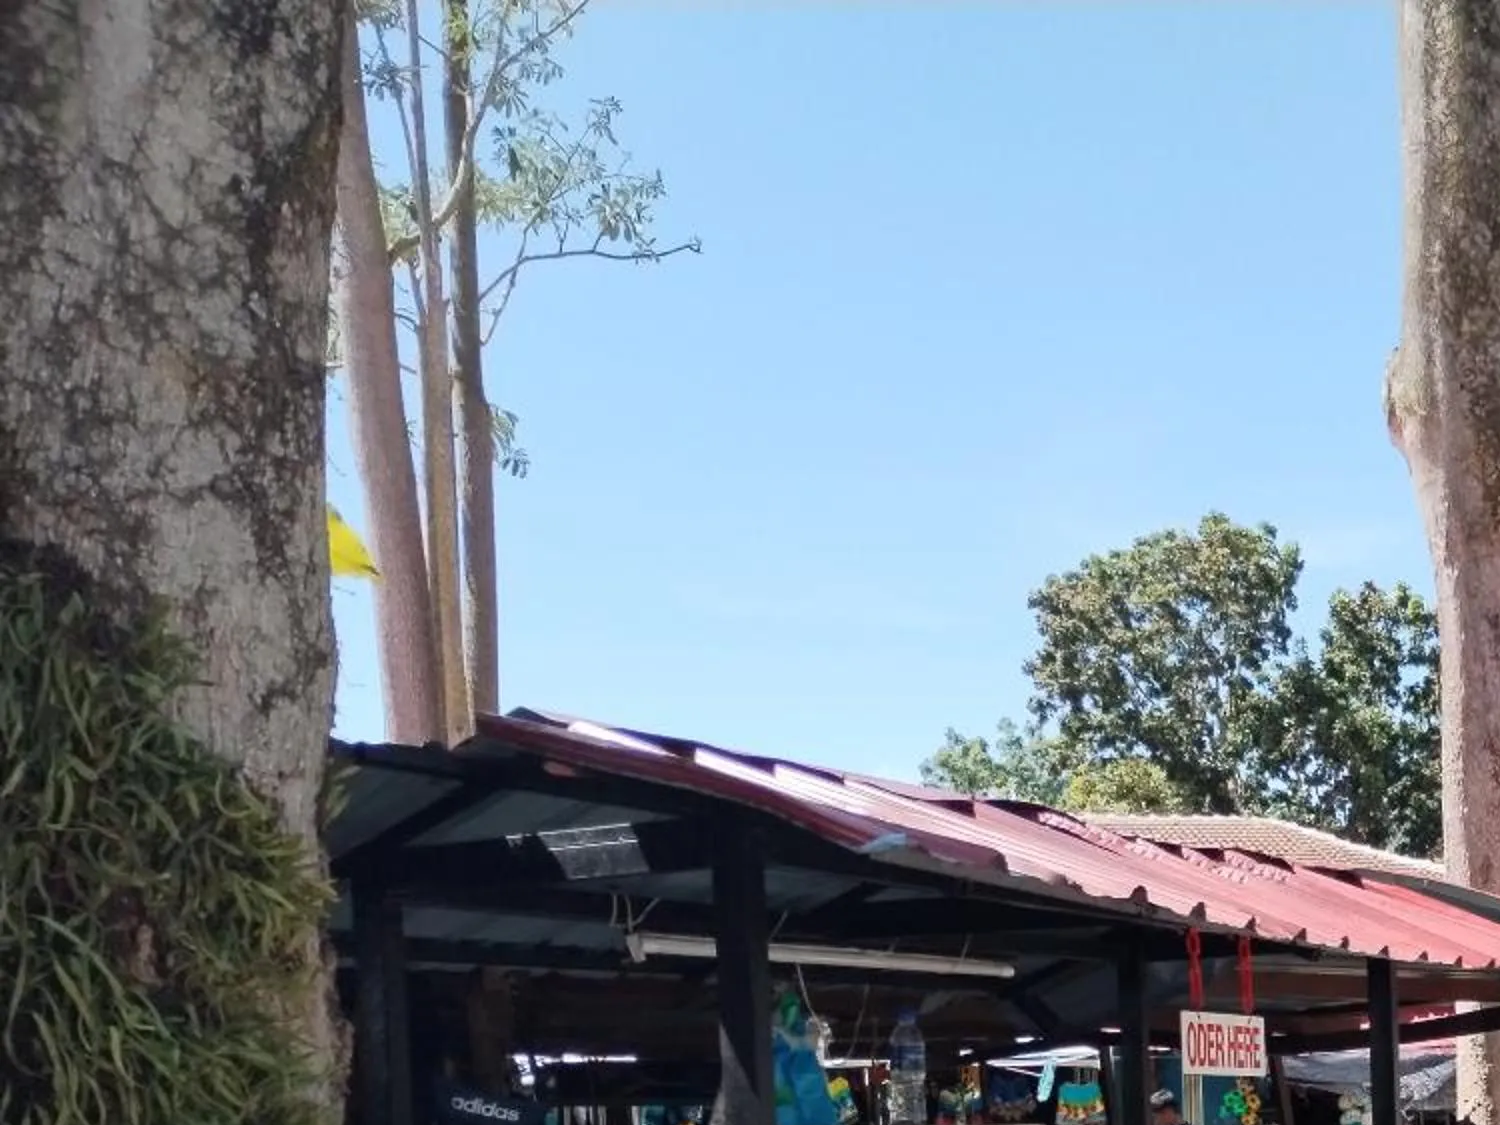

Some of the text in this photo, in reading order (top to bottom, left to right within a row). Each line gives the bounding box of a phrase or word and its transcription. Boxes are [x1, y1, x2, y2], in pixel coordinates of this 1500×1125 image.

[1186, 1021, 1262, 1069] ODER HERE
[450, 1096, 520, 1121] adidas
